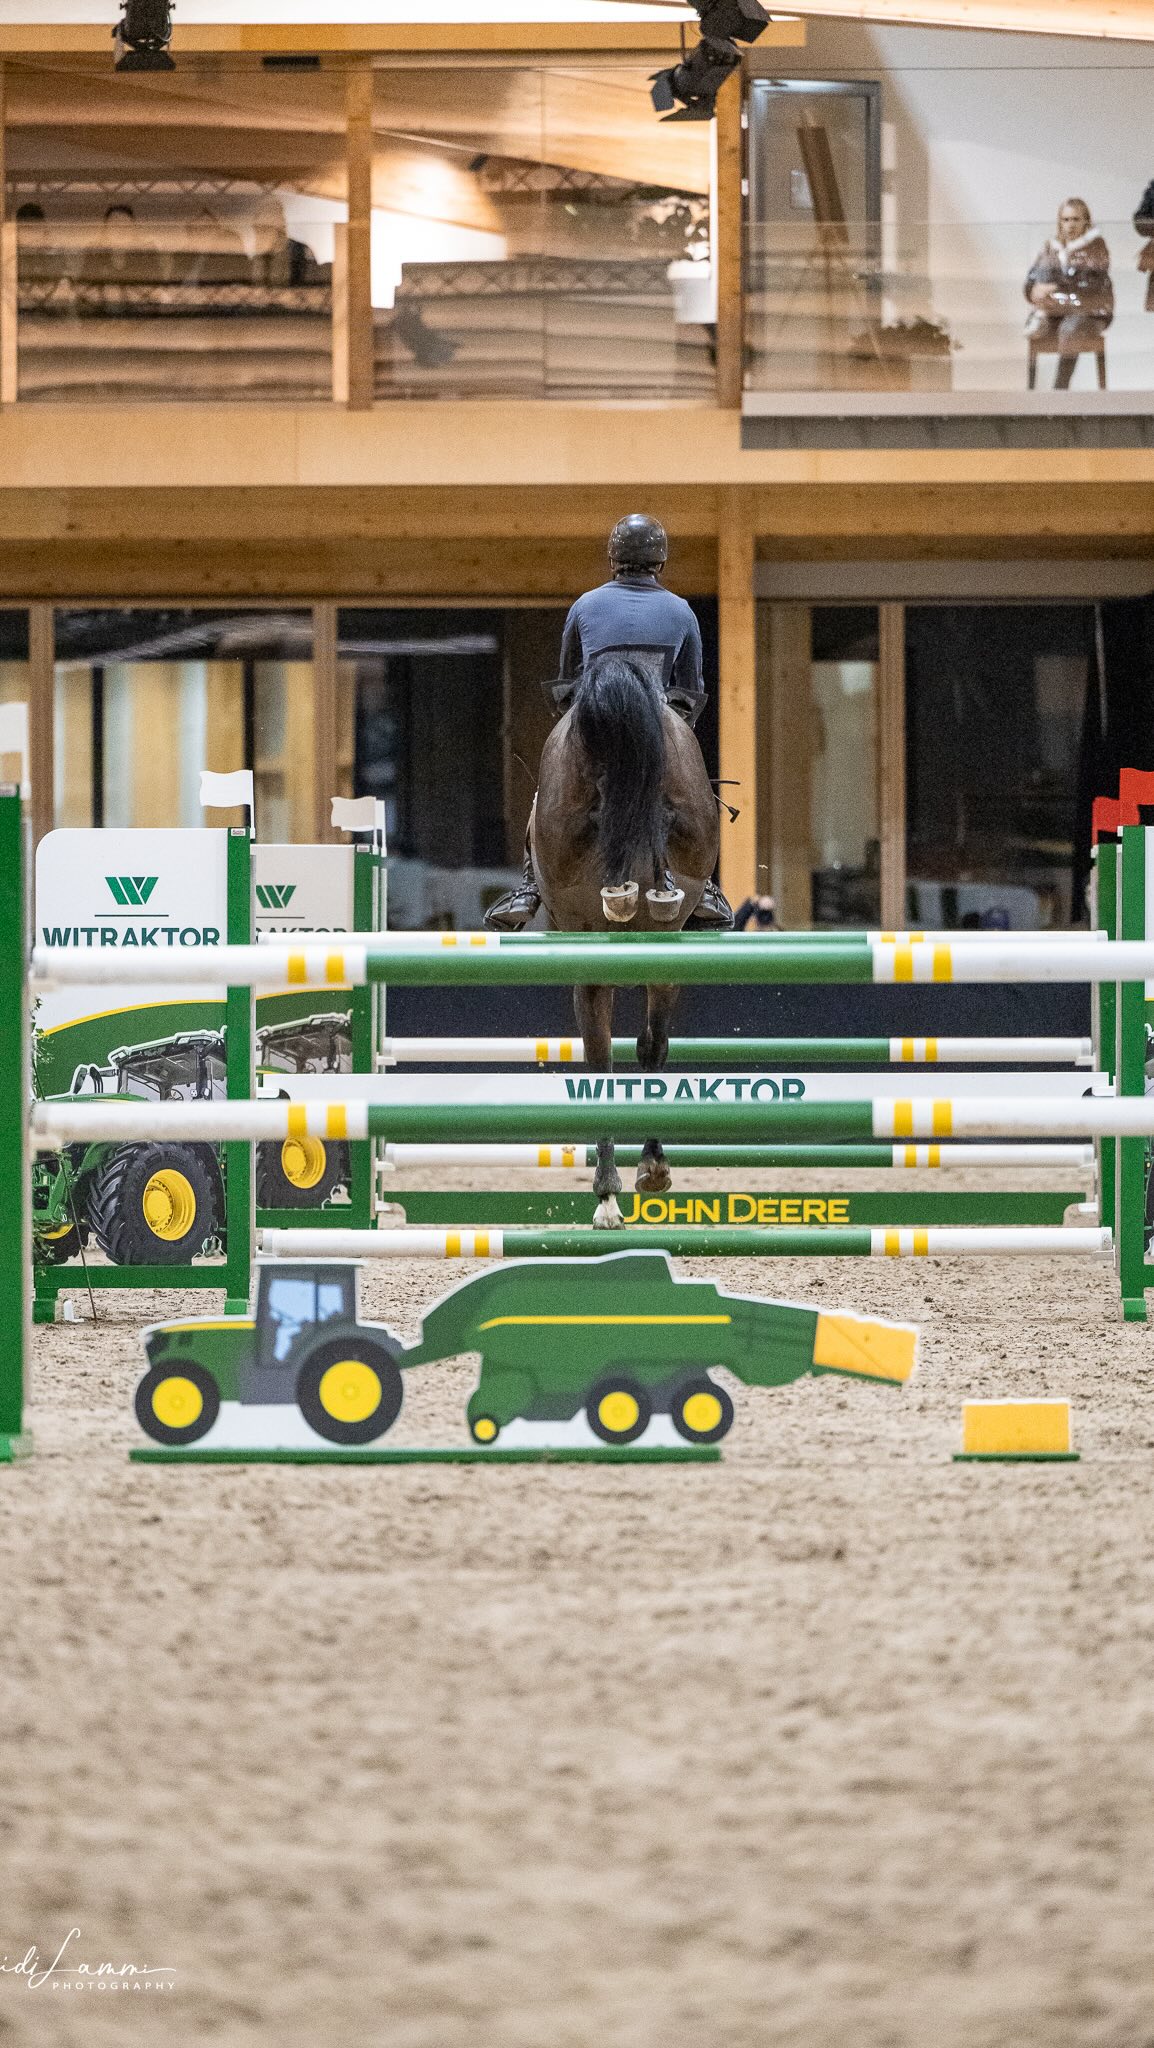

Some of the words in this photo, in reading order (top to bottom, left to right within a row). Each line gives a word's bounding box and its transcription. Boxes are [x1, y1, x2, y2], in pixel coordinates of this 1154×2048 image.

[42, 927, 220, 947] WITRAKTOR
[565, 1078, 806, 1102] WITRAKTOR
[623, 1193, 720, 1223] JOHN
[728, 1193, 850, 1223] DEERE
